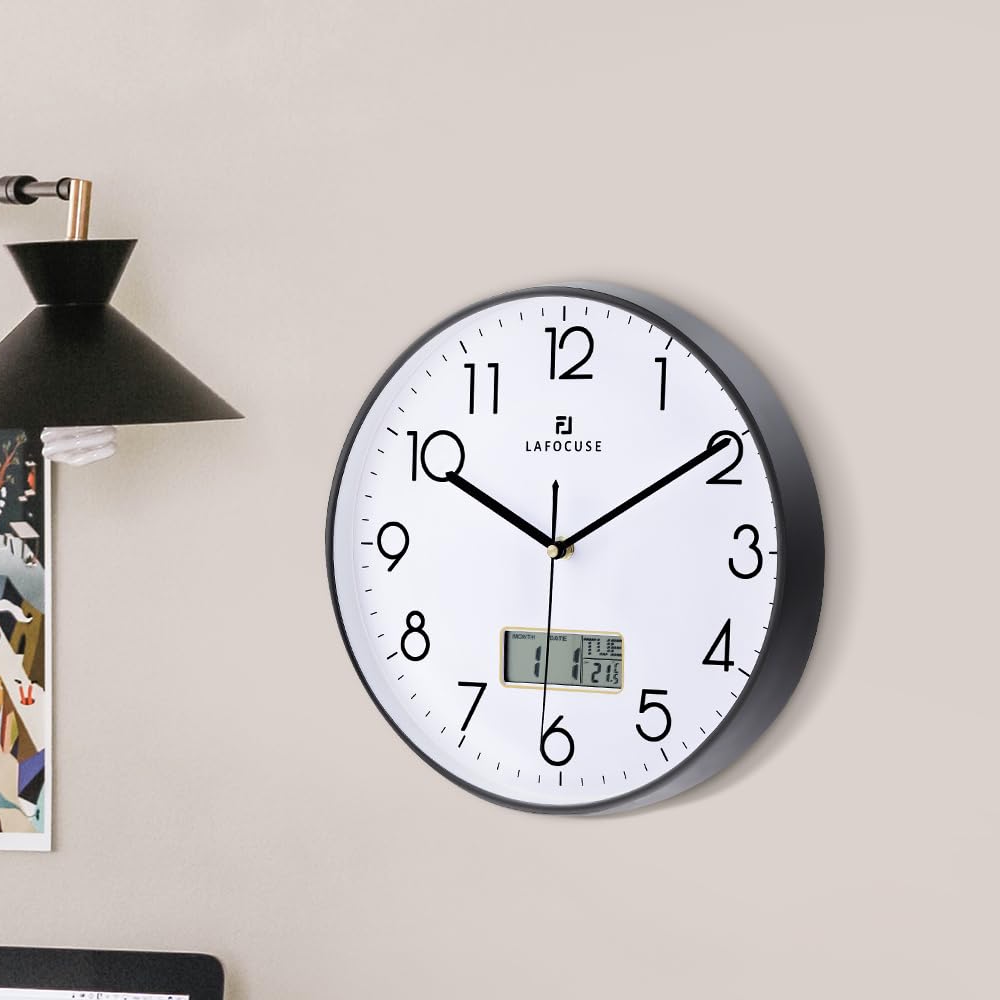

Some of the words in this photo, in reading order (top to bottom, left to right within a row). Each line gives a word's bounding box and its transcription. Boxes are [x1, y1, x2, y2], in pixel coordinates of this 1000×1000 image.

[545, 325, 595, 380] 12
[463, 362, 500, 415] 11
[654, 356, 667, 411] 1
[406, 429, 466, 483] 10
[525, 440, 602, 453] LAFOCUSE
[705, 429, 745, 486] 2
[376, 521, 410, 573] 9
[728, 523, 764, 580] 3
[400, 610, 431, 662] 8
[534, 646, 542, 678] 1
[701, 617, 735, 673] 4
[572, 647, 580, 680] 1
[457, 680, 488, 733] 7
[635, 688, 672, 743] 5
[539, 714, 575, 767] 6
